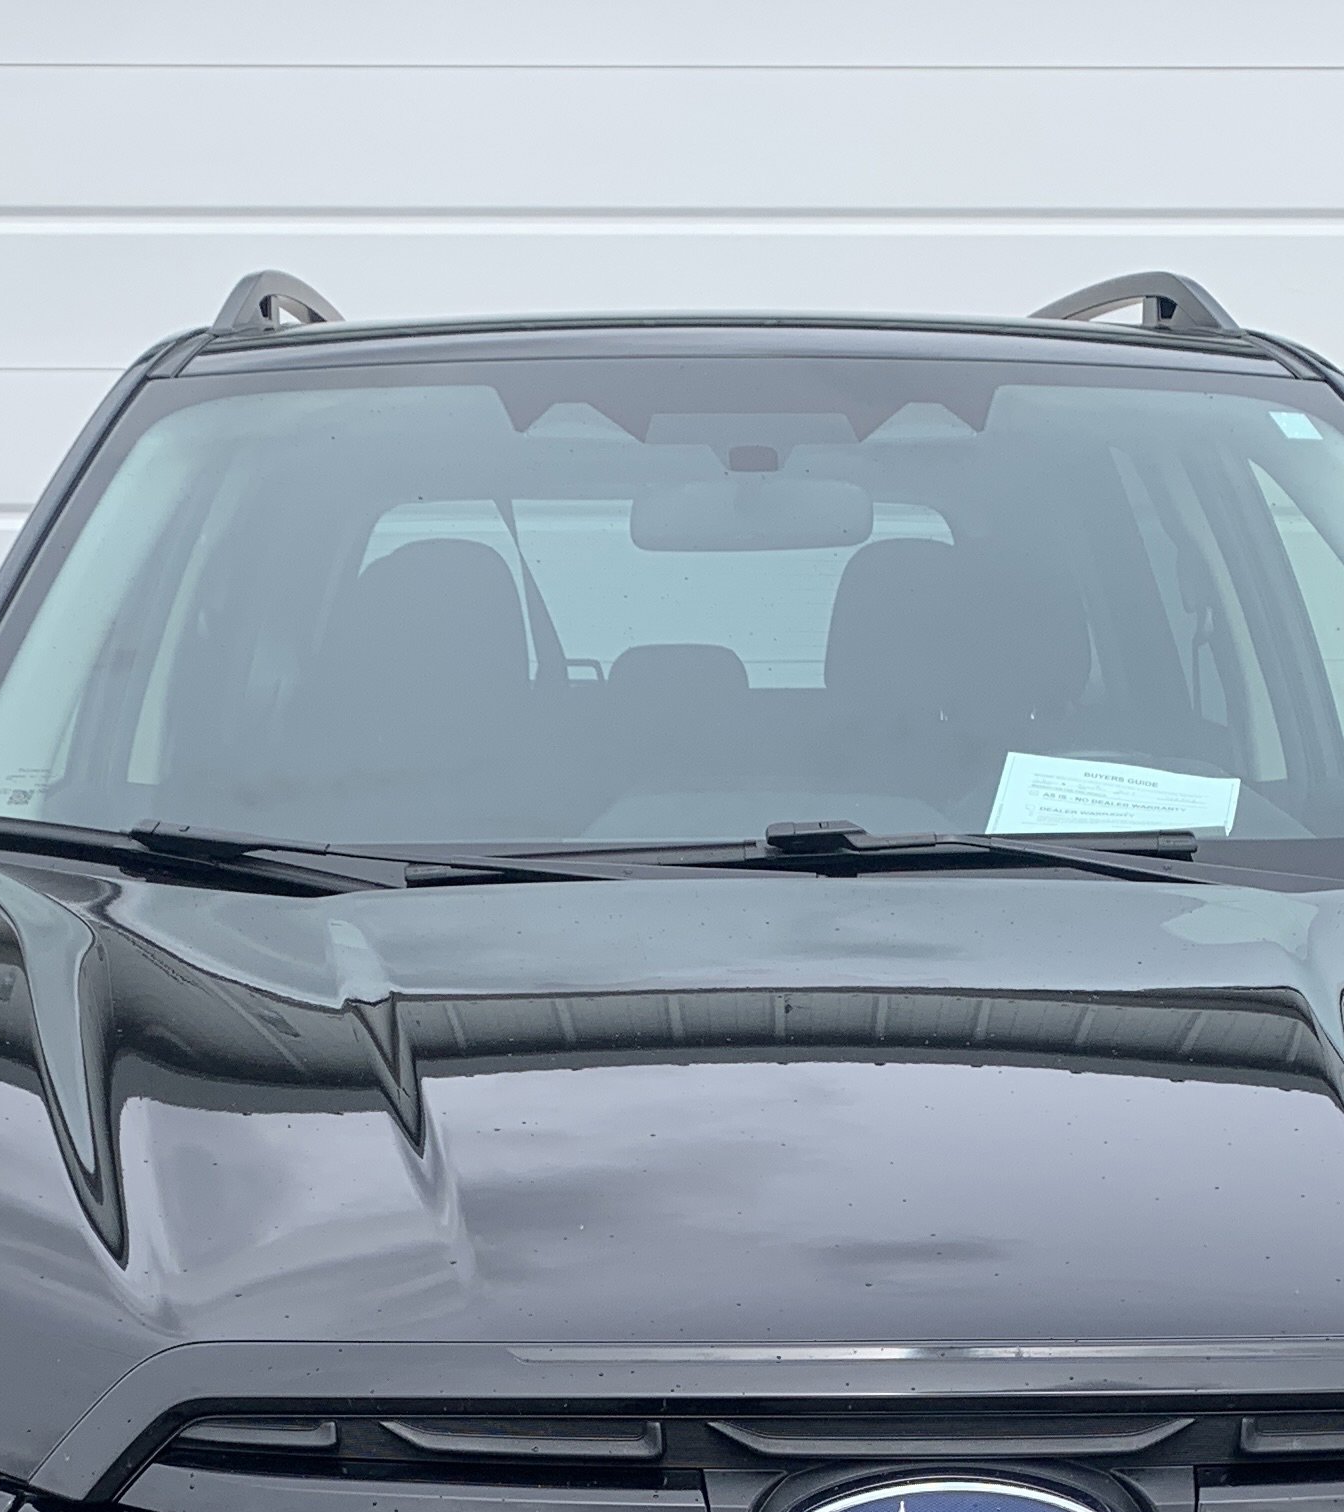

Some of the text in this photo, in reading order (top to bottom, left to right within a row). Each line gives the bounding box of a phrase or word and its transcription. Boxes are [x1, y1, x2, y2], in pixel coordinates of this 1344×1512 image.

[1083, 771, 1159, 788] BUYERS GUIDE
[1039, 806, 1078, 815] DEALER
[1091, 799, 1129, 807] DEALER
[1131, 803, 1187, 812] WARRANTY
